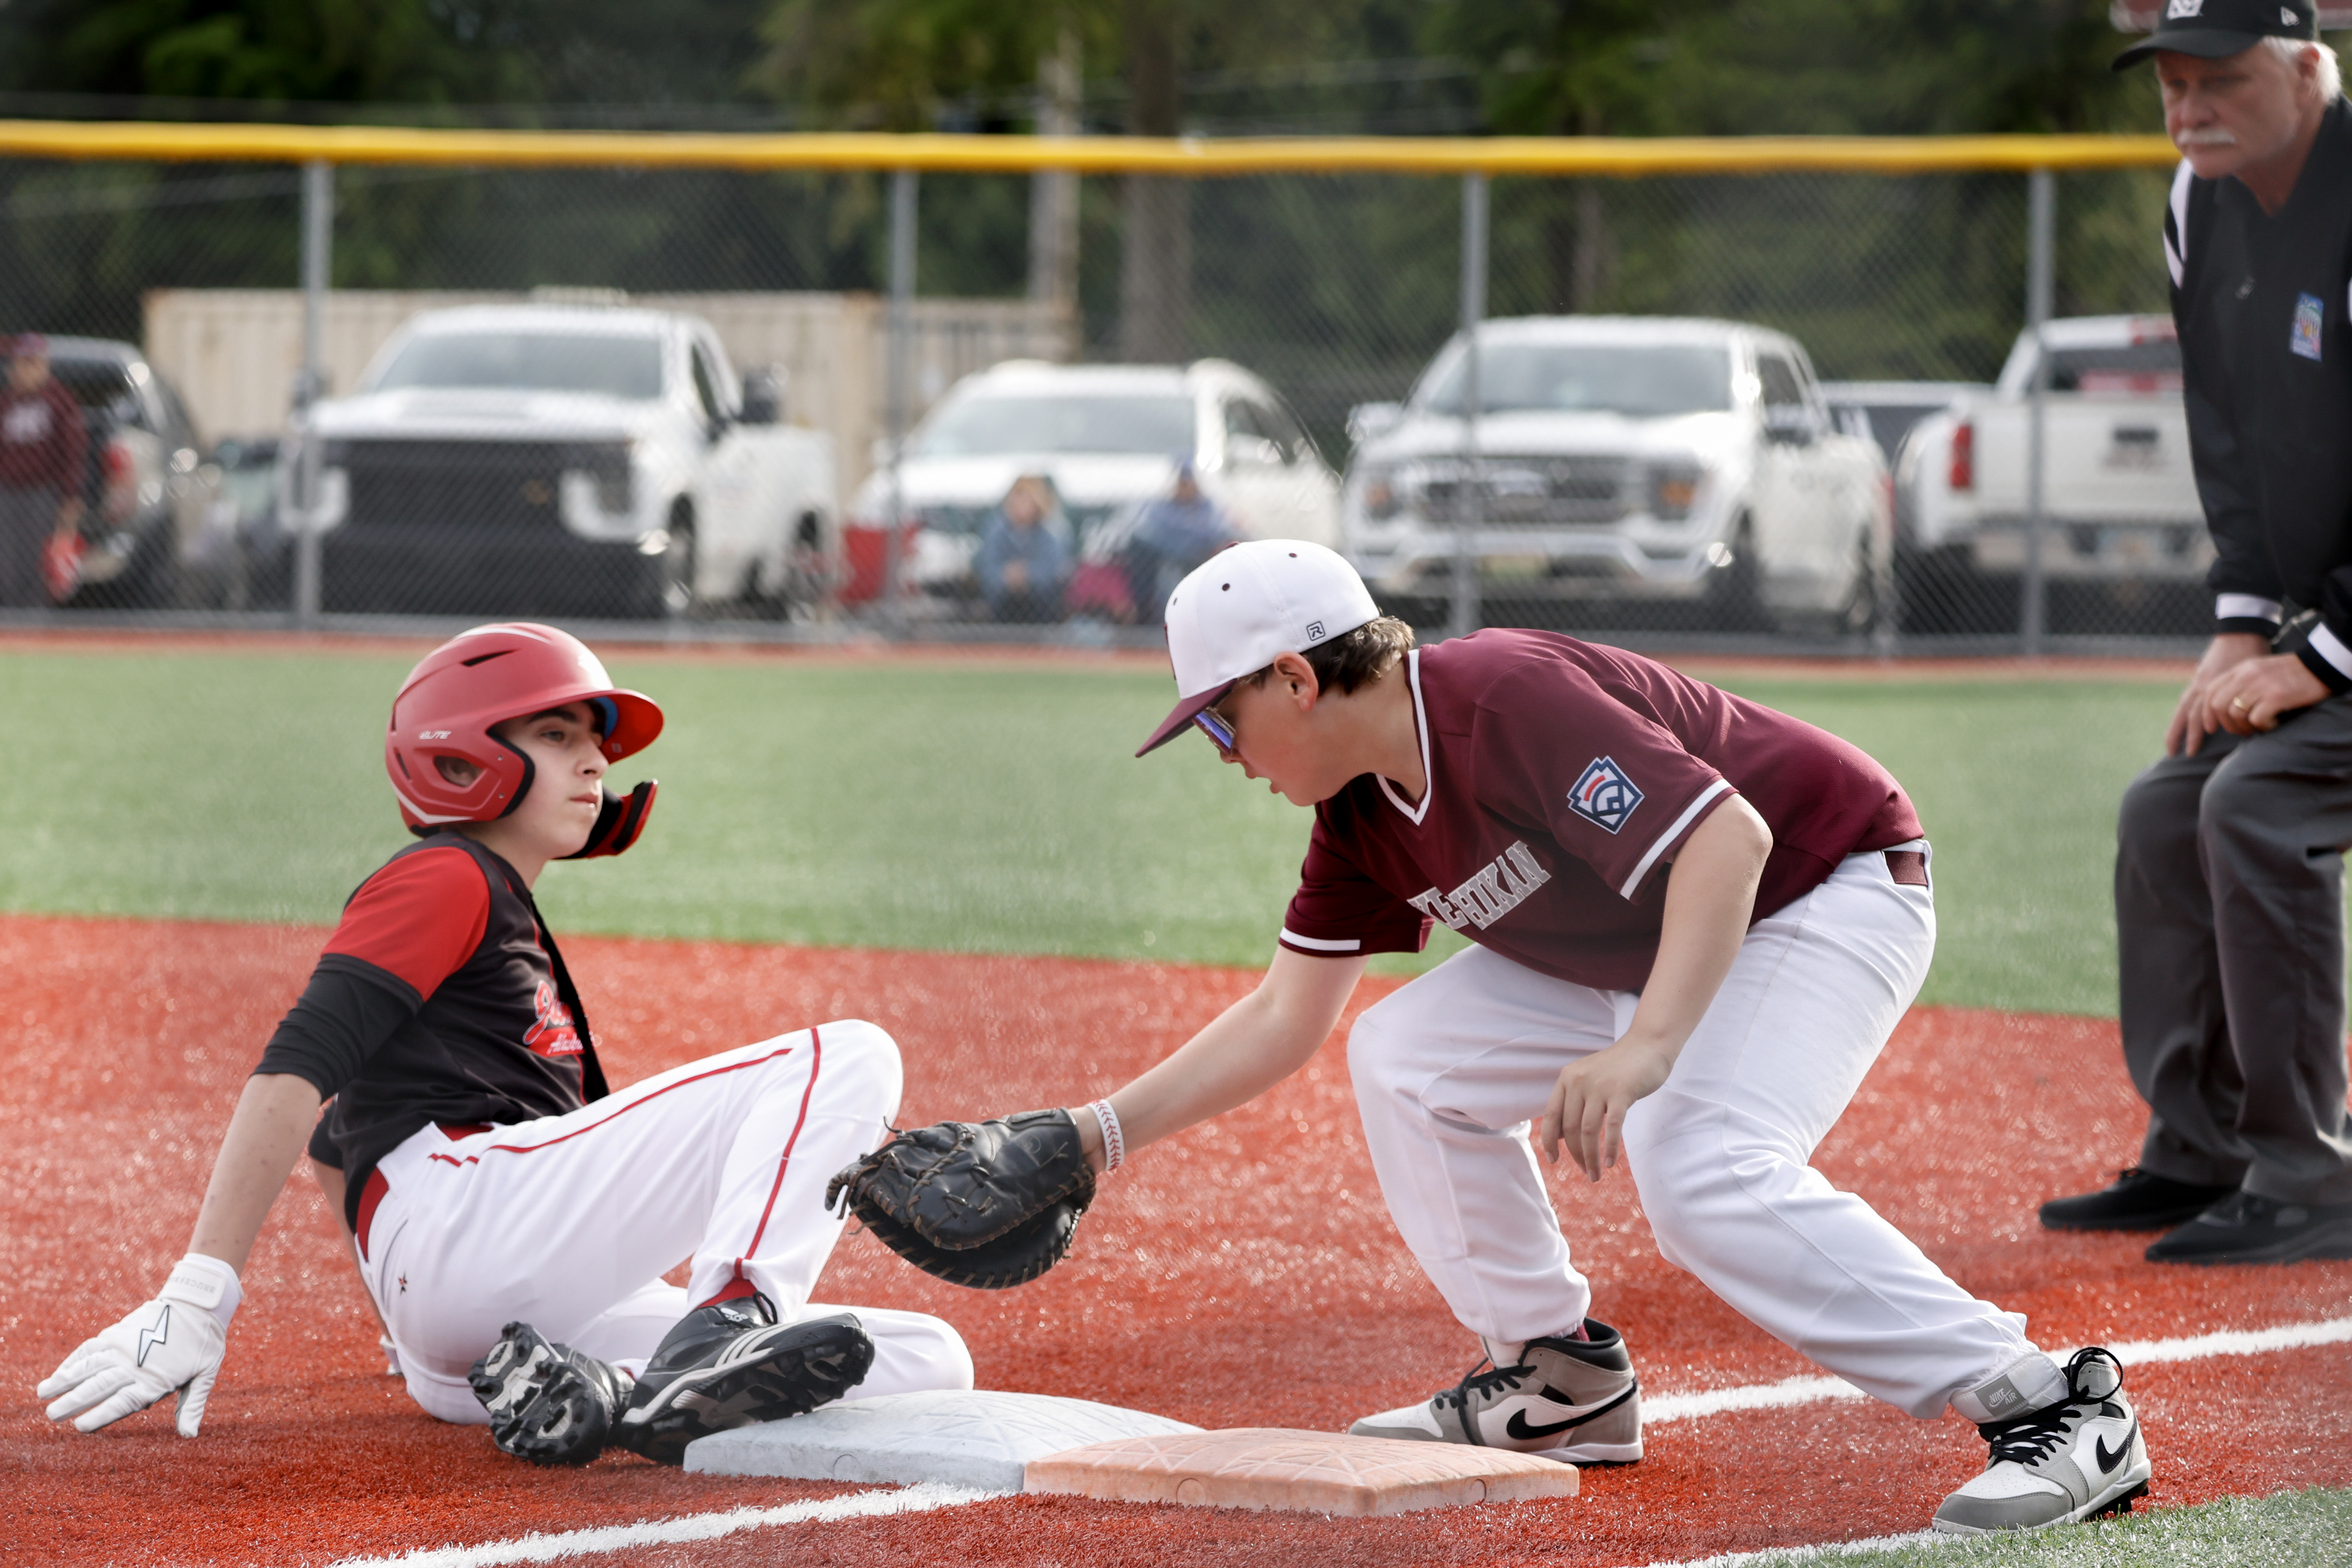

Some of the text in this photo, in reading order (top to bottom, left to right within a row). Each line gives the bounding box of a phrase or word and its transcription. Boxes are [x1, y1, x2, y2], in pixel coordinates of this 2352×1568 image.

[419, 730, 451, 739] ELITE
[1989, 1388, 2005, 1404] NIKE
[2005, 1392, 2018, 1405] AIR
